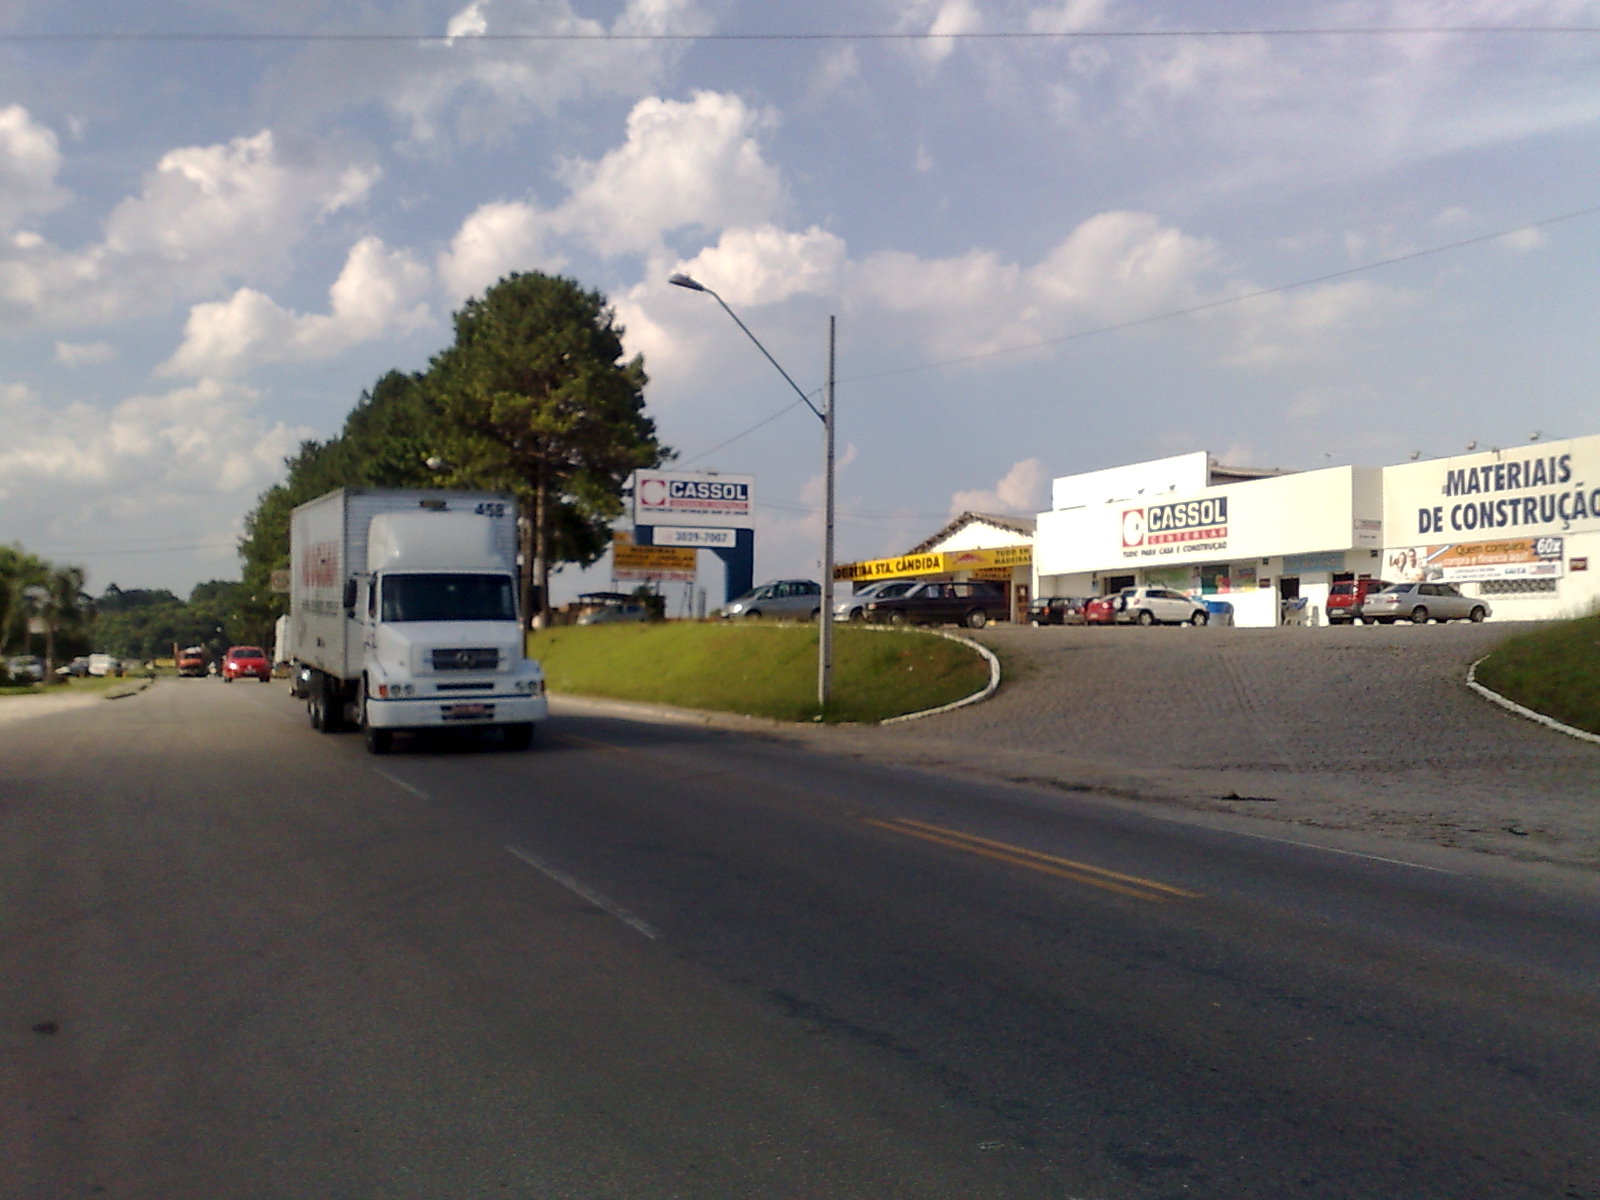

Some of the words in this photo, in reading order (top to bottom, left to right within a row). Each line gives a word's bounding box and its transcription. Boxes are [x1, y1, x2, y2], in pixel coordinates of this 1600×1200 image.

[671, 482, 746, 500] CASSOL
[1446, 454, 1571, 497] MATERIAIS
[1149, 499, 1226, 530] CASSOL
[1418, 506, 1443, 534] DE
[1451, 482, 1600, 530] CONSTRUÇÃO
[1455, 544, 1482, 556] Quem
